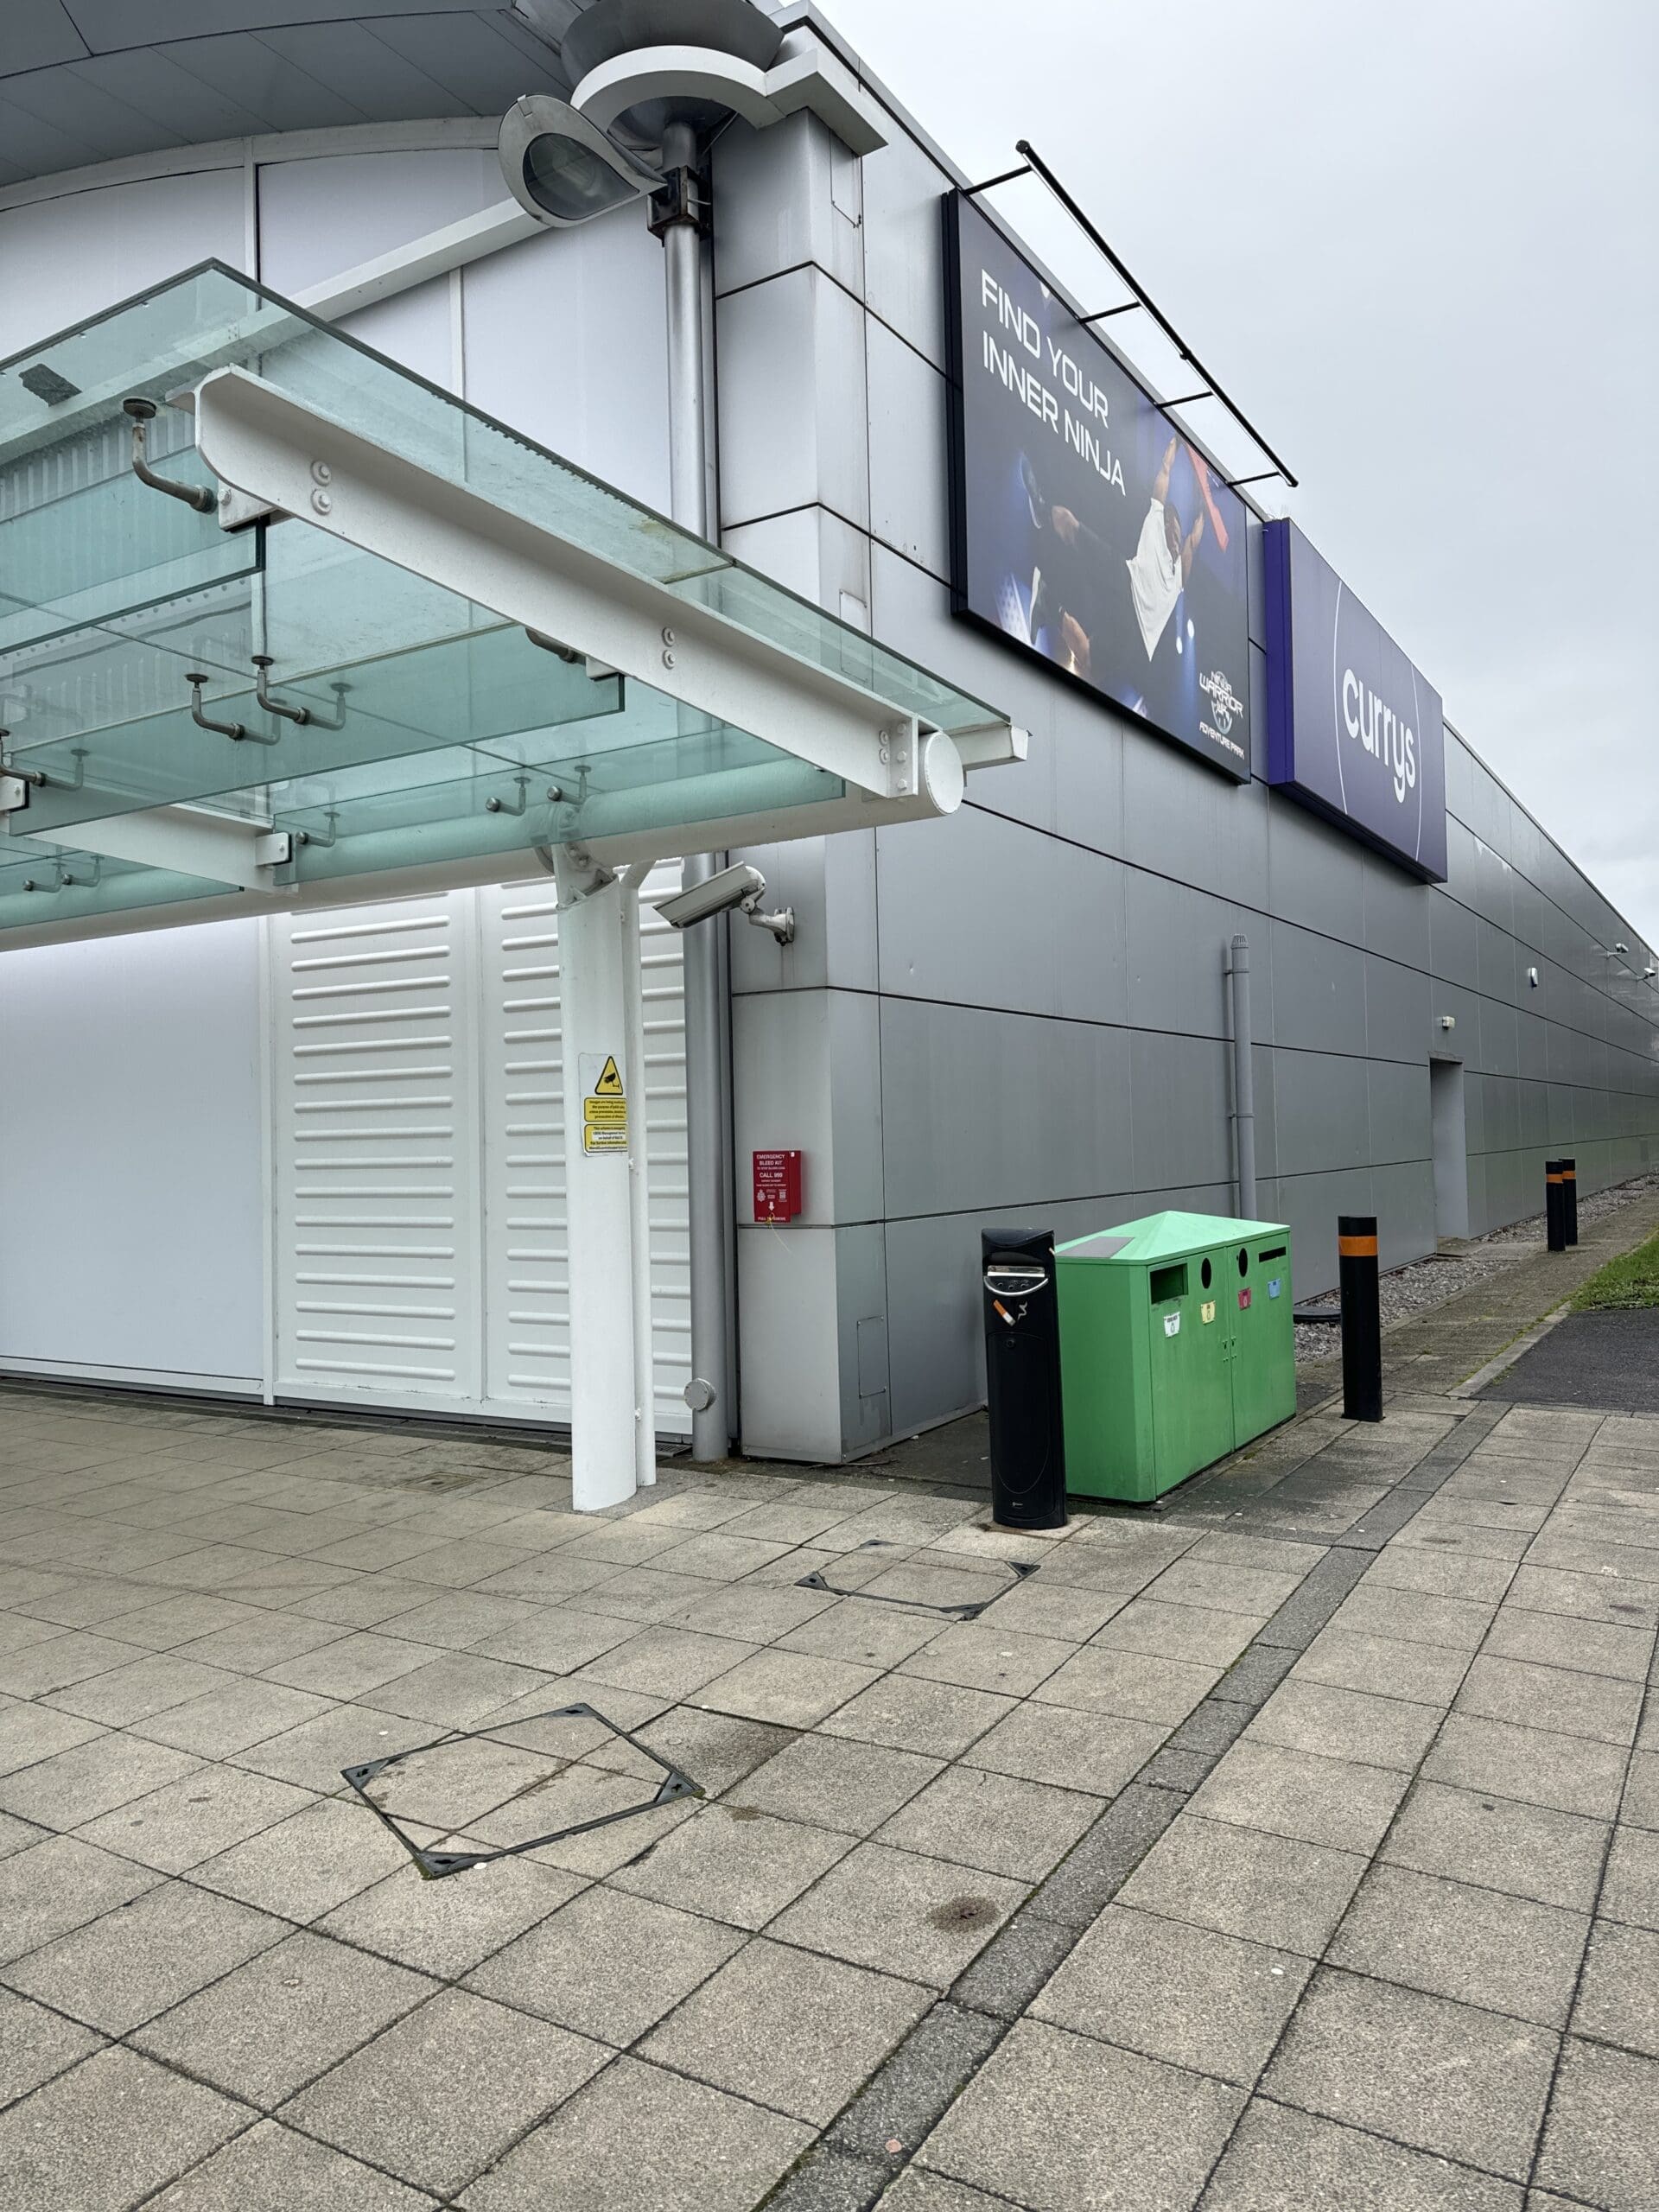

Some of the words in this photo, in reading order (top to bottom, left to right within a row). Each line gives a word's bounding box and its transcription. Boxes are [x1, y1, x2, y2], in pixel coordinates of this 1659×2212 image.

[982, 269, 1041, 359] FIND
[1047, 335, 1109, 429] YOUR
[983, 329, 1058, 435] INNER
[1064, 407, 1126, 496] NINJA
[1198, 721, 1230, 749] ADVENTURE
[1230, 741, 1245, 760] PARK
[1199, 672, 1244, 719] WARRIOR
